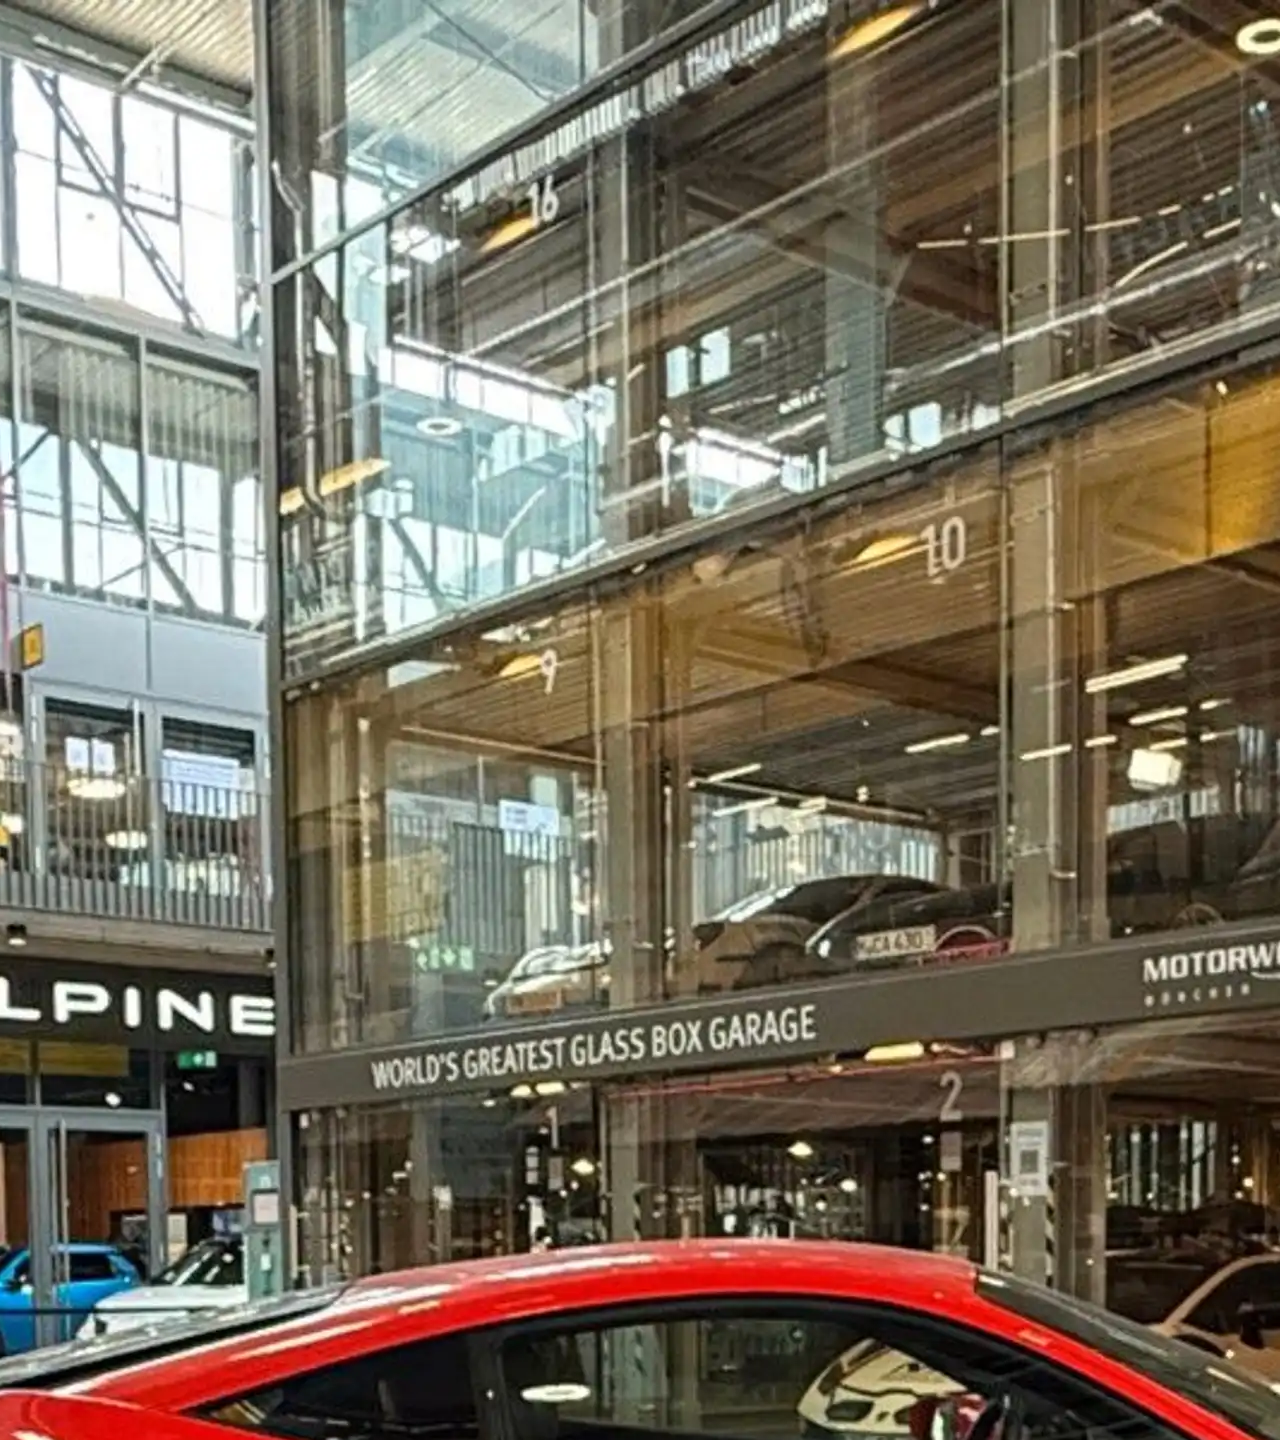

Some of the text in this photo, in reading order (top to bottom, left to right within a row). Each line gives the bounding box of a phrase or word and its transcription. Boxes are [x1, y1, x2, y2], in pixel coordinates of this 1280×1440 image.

[526, 175, 560, 229] 16
[919, 515, 966, 577] 10
[540, 649, 558, 696] 9
[371, 1004, 817, 1090] WORLD'S GREATEST GLASS BOX GARAGE
[939, 1070, 963, 1122] 2
